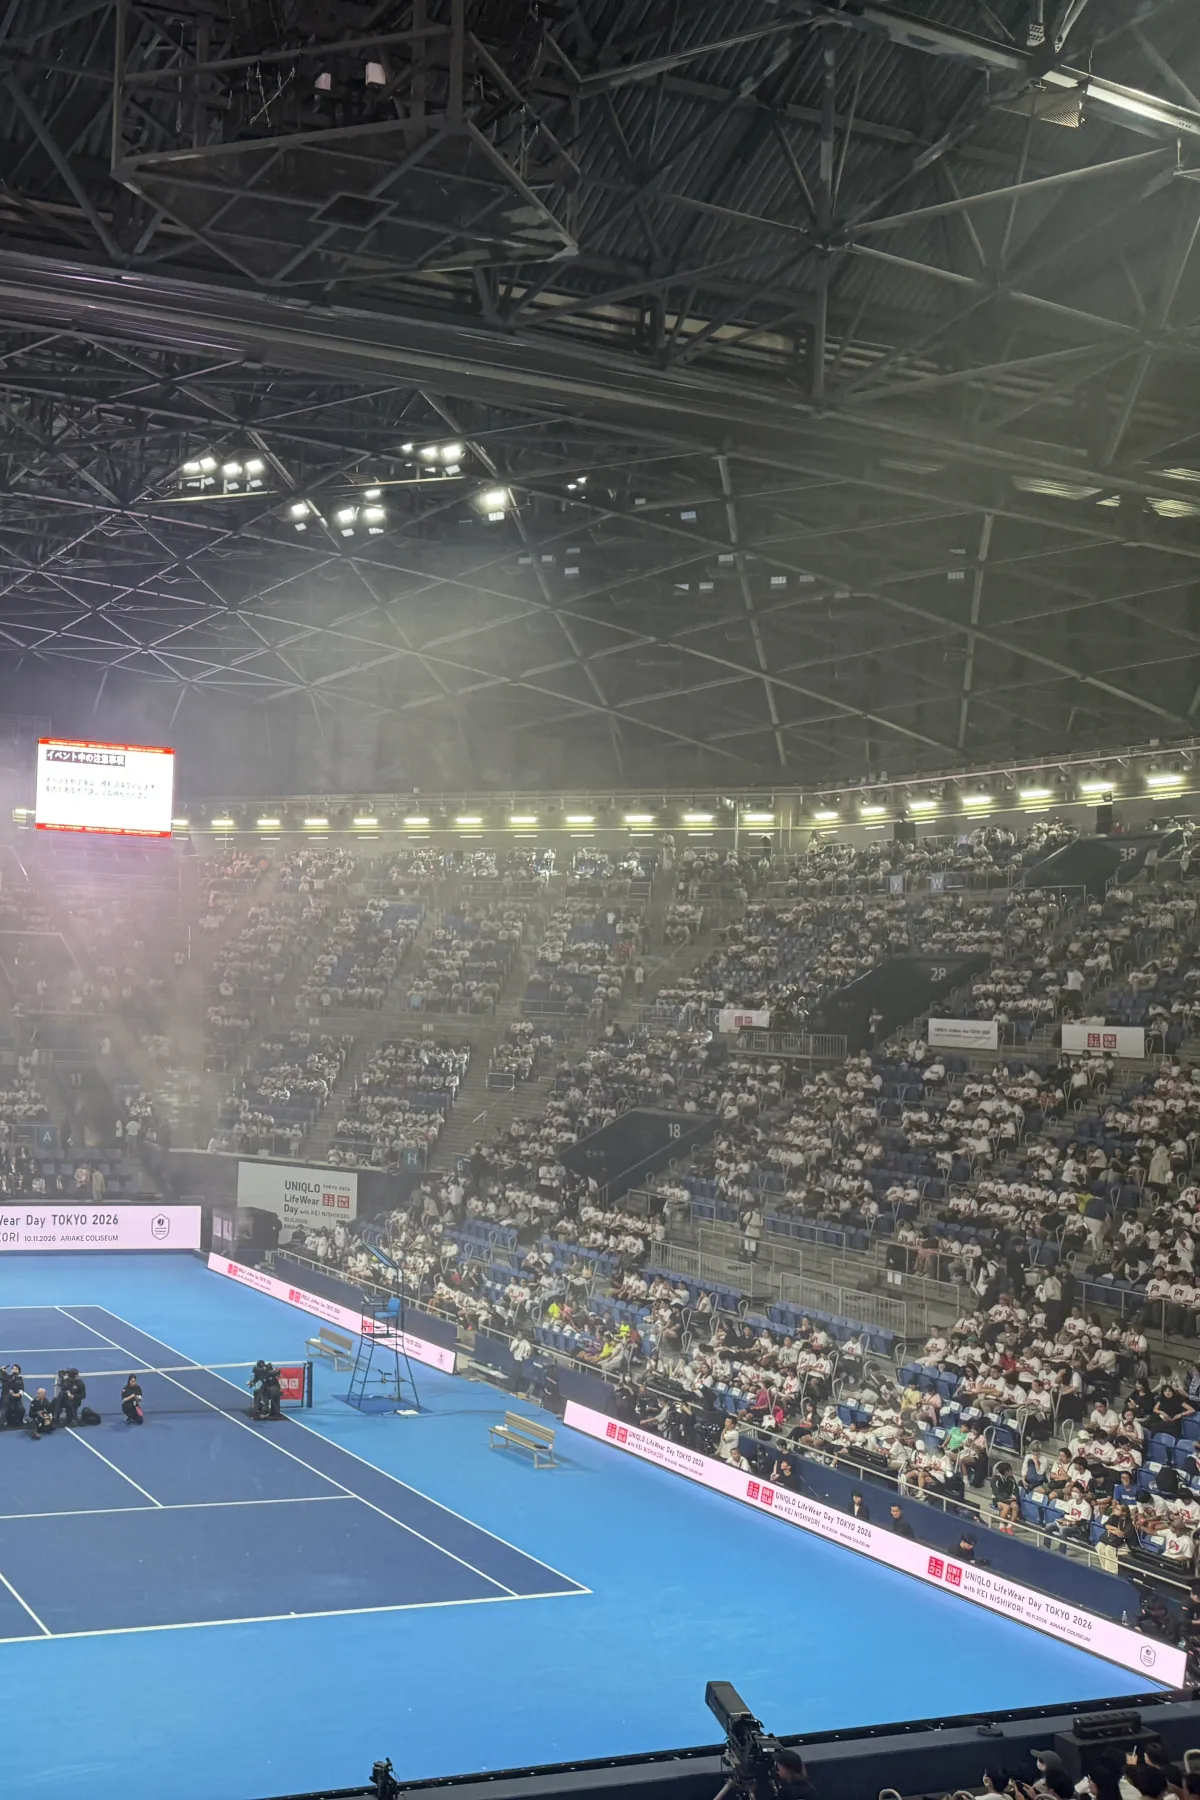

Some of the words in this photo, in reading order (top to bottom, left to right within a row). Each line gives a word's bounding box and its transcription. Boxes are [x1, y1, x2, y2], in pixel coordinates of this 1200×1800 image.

[43, 1131, 52, 1142] A
[668, 1123, 681, 1138] 18
[407, 1153, 417, 1165] H
[284, 1180, 321, 1194] UNIQLO
[284, 1193, 320, 1205] LifeWear
[284, 1204, 299, 1215] Day
[26, 1214, 46, 1228] Day
[51, 1214, 88, 1226] TOKYO
[92, 1213, 119, 1225] 2026
[60, 1234, 84, 1242] ARIAKE
[85, 1234, 119, 1242] COLISEUM
[776, 1491, 796, 1506] UNIQLO
[798, 1501, 821, 1516] LifeWear
[824, 1511, 835, 1523] Day
[837, 1517, 855, 1531] TOKYO
[857, 1526, 872, 1538] 2026
[947, 1564, 960, 1577] UNI
[946, 1573, 960, 1584] QLO
[963, 1585, 975, 1593] with
[977, 1588, 988, 1598] KEI
[989, 1594, 1023, 1614] NISHIKORI
[965, 1570, 991, 1587] UNIQLO
[993, 1582, 1025, 1602] LifeWear
[1028, 1597, 1042, 1611] Day
[1045, 1603, 1070, 1620] TOKYO
[1073, 1615, 1092, 1630] 2026
